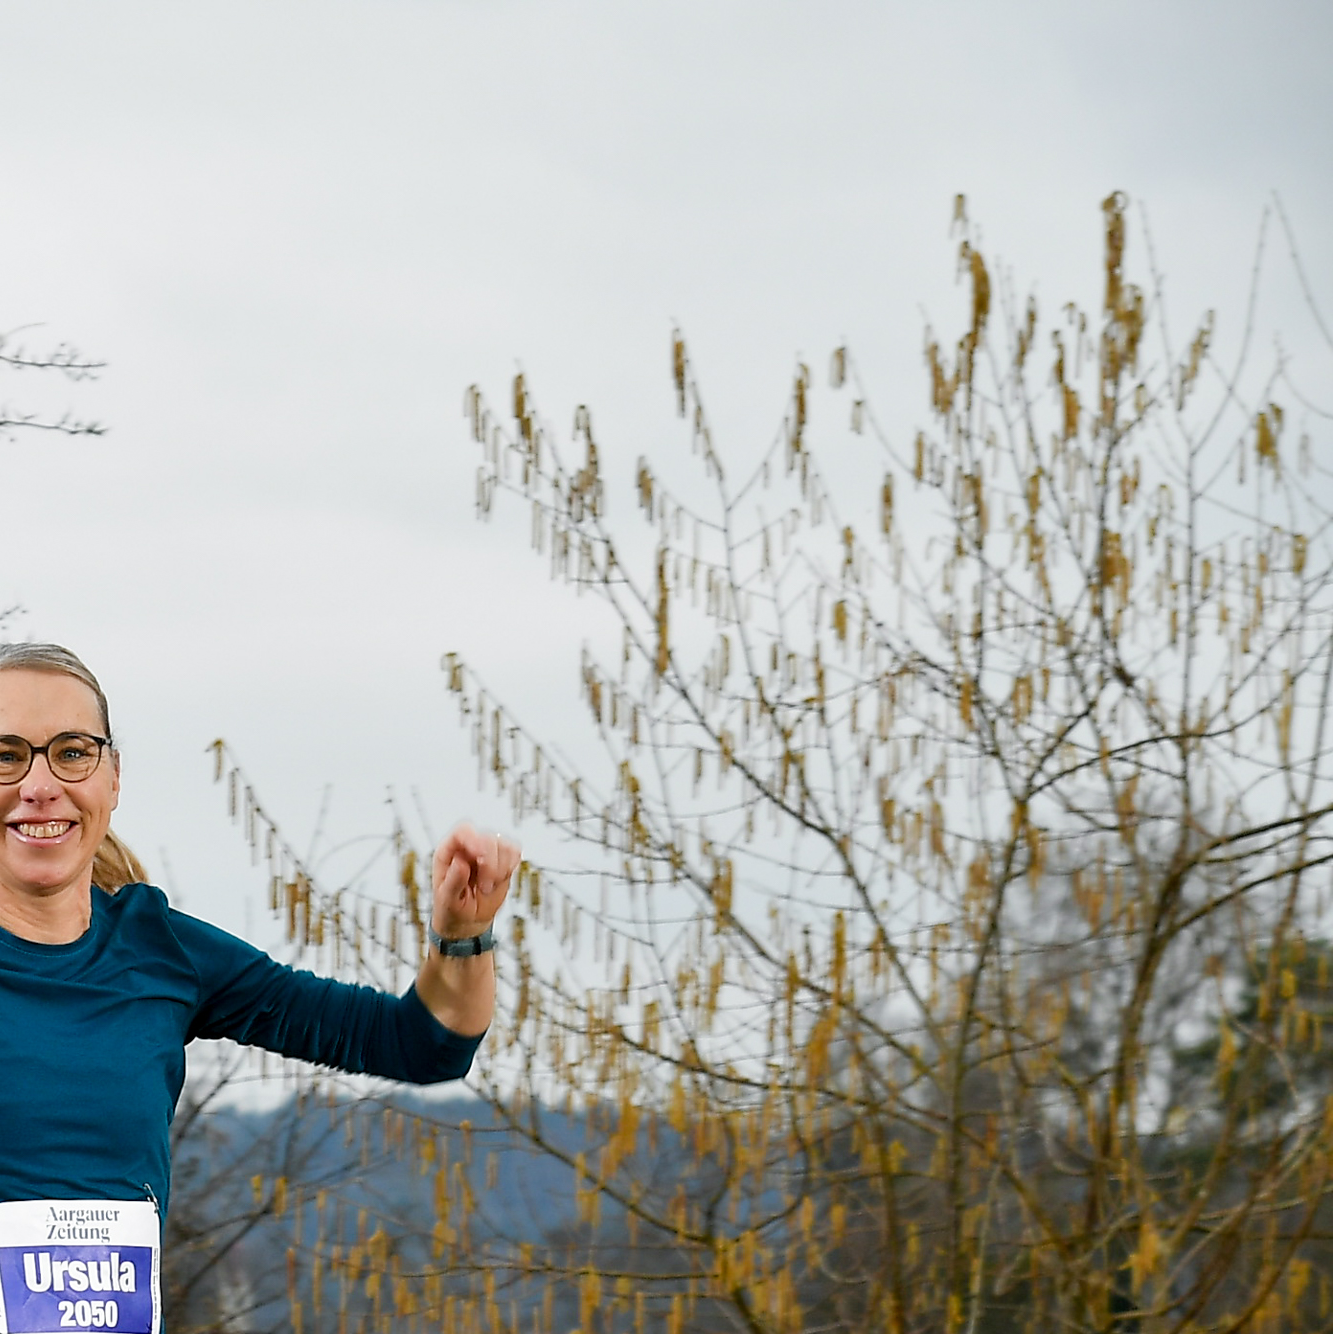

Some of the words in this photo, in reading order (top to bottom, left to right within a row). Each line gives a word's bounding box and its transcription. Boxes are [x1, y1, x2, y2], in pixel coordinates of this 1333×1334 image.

[46, 1206, 120, 1225] Aargauer
[46, 1223, 111, 1243] Zeitung
[23, 1252, 136, 1293] Ursula
[58, 1300, 119, 1328] 2050
